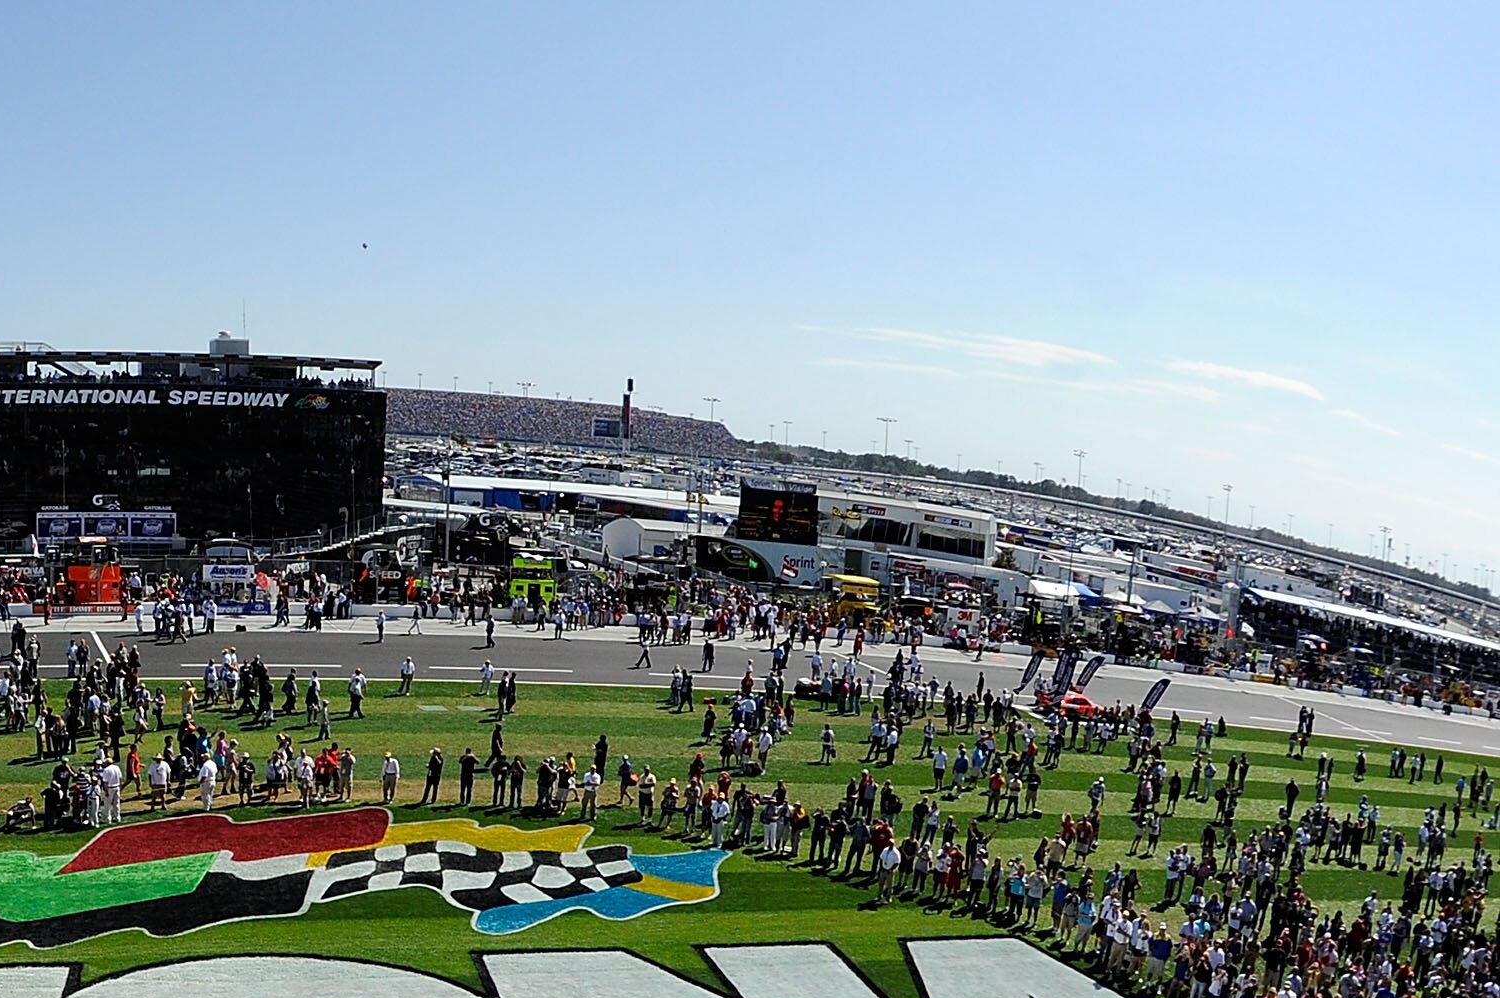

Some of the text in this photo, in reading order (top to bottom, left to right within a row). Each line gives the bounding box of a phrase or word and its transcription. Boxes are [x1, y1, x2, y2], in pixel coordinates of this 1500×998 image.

[167, 389, 290, 408] SPEEDWAY
[92, 494, 103, 506] G
[479, 513, 491, 527] G
[783, 555, 816, 570] Sprint
[957, 610, 974, 622] 3M
